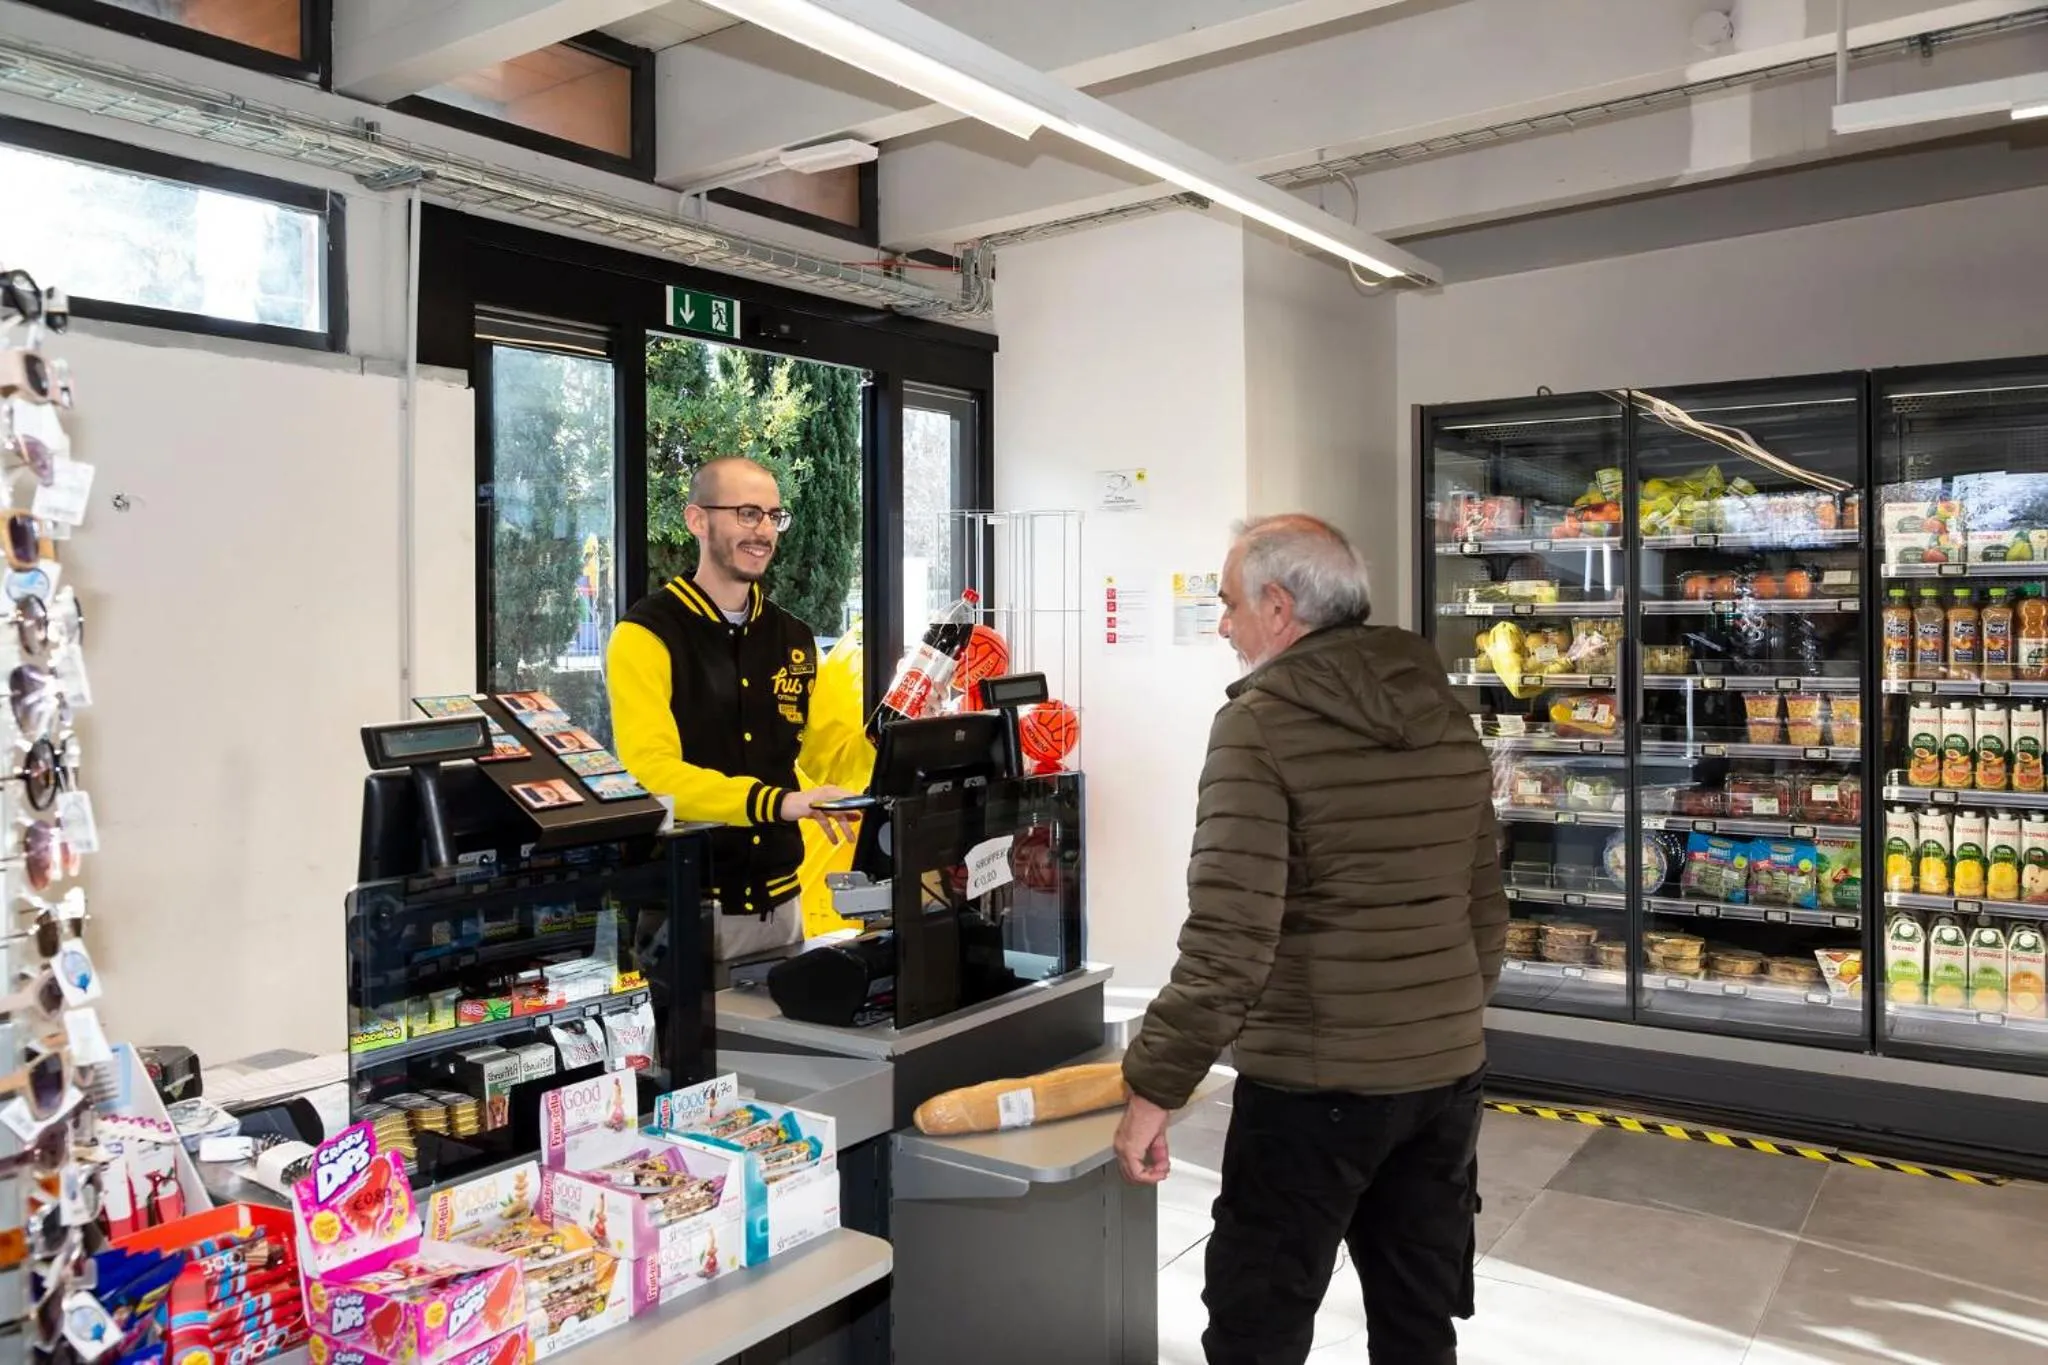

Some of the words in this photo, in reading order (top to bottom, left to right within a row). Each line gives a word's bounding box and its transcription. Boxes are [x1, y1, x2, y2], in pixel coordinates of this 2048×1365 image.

[319, 1128, 365, 1163] CRAZY
[317, 1140, 369, 1203] DIPS
[336, 1295, 364, 1307] CRAZY
[449, 1288, 486, 1338] DIPS
[332, 1306, 365, 1335] DIPS
